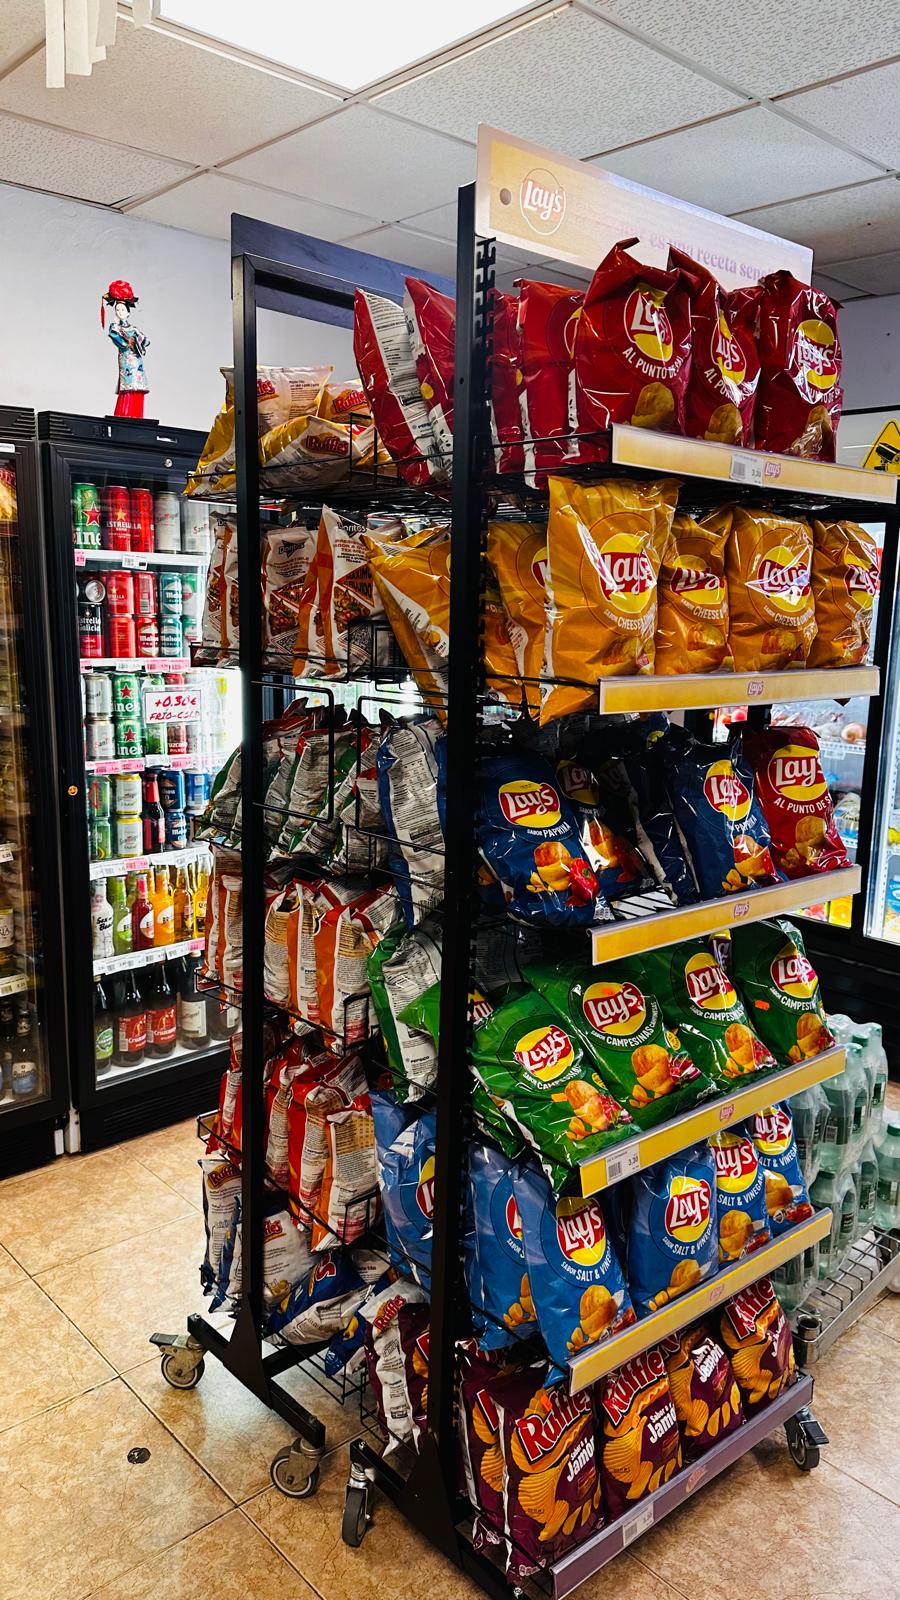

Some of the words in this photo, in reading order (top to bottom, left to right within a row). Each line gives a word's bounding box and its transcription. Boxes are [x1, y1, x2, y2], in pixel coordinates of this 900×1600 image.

[523, 180, 563, 221] Lay's
[697, 246, 737, 274] receta
[623, 347, 636, 364] AL
[636, 358, 667, 379] PUNTO
[704, 368, 717, 384] AL
[306, 435, 349, 455] Ruffles
[693, 605, 720, 620] CHEESE
[505, 786, 553, 819] Lay's
[774, 796, 785, 809] AL
[786, 803, 815, 815] PUNTO
[817, 801, 827, 812] DE
[543, 821, 571, 838] PAPRIKA
[588, 987, 638, 1028] Lay's
[606, 1026, 655, 1047] CAMPESINAS
[517, 1030, 566, 1070] Lay's
[773, 1158, 778, 1167] &
[670, 1184, 710, 1227] Lay's
[717, 1193, 735, 1206] SALT
[737, 1196, 743, 1206] &
[560, 1204, 602, 1251] Lay's
[672, 1243, 689, 1255] SALT
[691, 1245, 696, 1254] &
[696, 1217, 714, 1250] VINEGAR
[561, 1260, 576, 1276] SABOR
[575, 1269, 593, 1282] SALT
[594, 1270, 600, 1280] &
[374, 1294, 406, 1332] Ruffles
[650, 1408, 665, 1423] Sabor
[570, 1443, 582, 1461] Sabor
